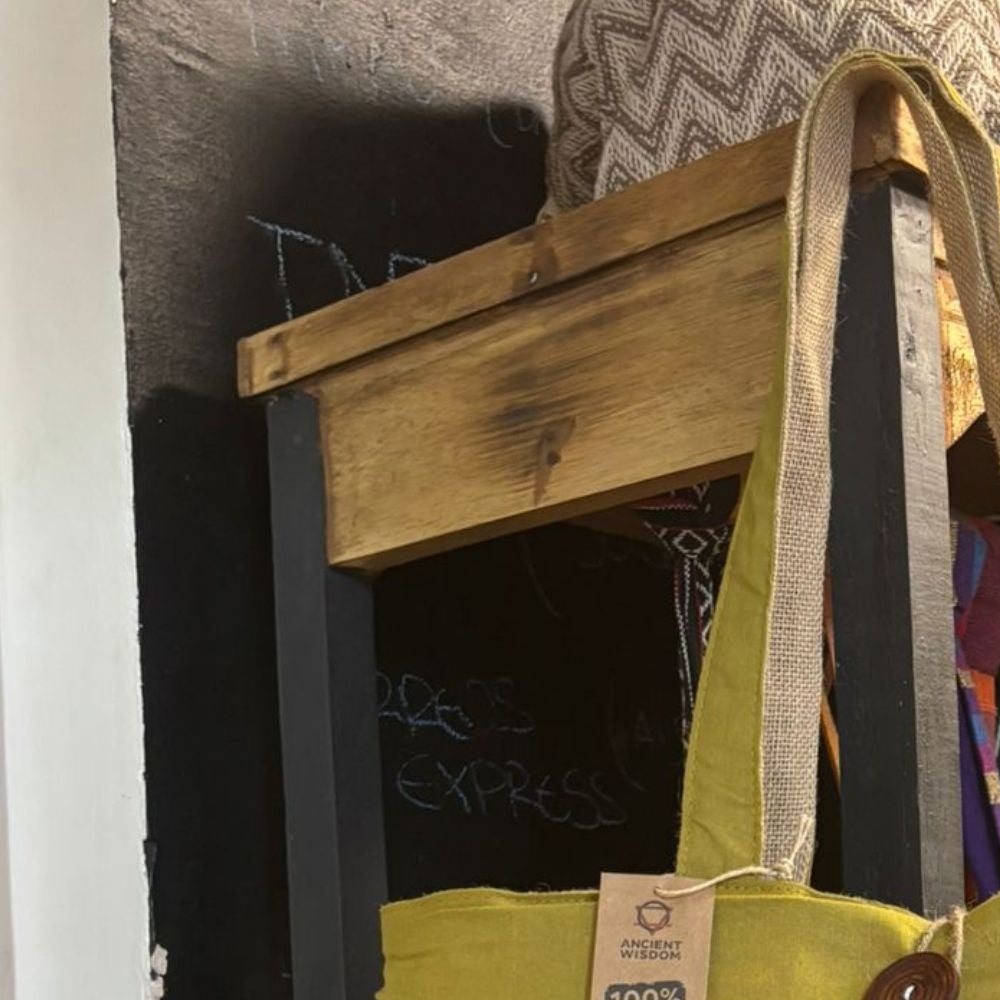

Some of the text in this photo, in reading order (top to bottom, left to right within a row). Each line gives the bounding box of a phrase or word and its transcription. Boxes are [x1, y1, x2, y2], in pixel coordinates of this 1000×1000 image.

[396, 753, 628, 830] EXPRESS
[620, 938, 682, 950] ANCIENT
[620, 949, 682, 961] WISDOM
